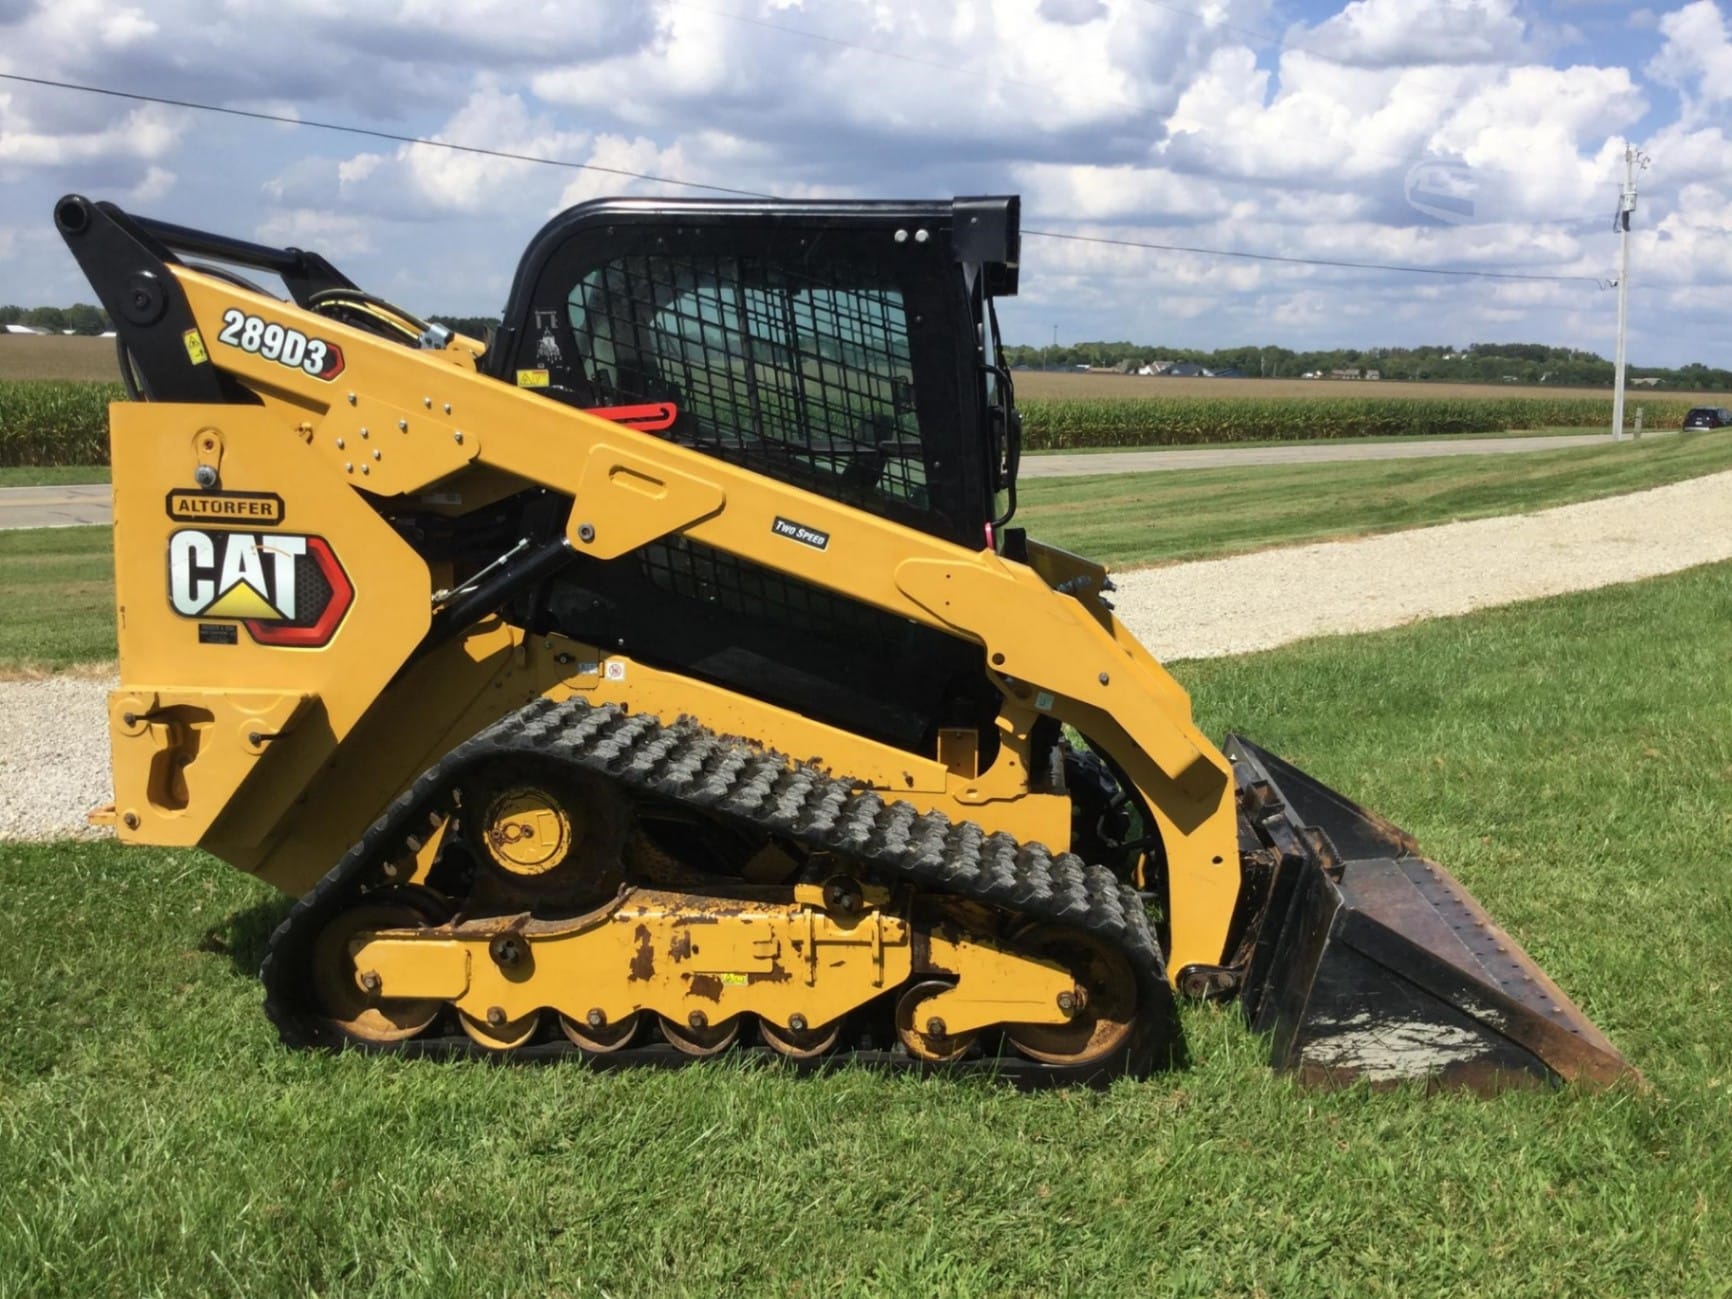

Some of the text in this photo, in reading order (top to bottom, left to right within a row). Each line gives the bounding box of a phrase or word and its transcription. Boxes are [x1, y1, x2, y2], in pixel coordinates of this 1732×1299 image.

[219, 309, 327, 376] 289D3
[178, 499, 273, 517] ALTORFER
[796, 528, 825, 545] SPEED
[170, 530, 307, 620] CAT
